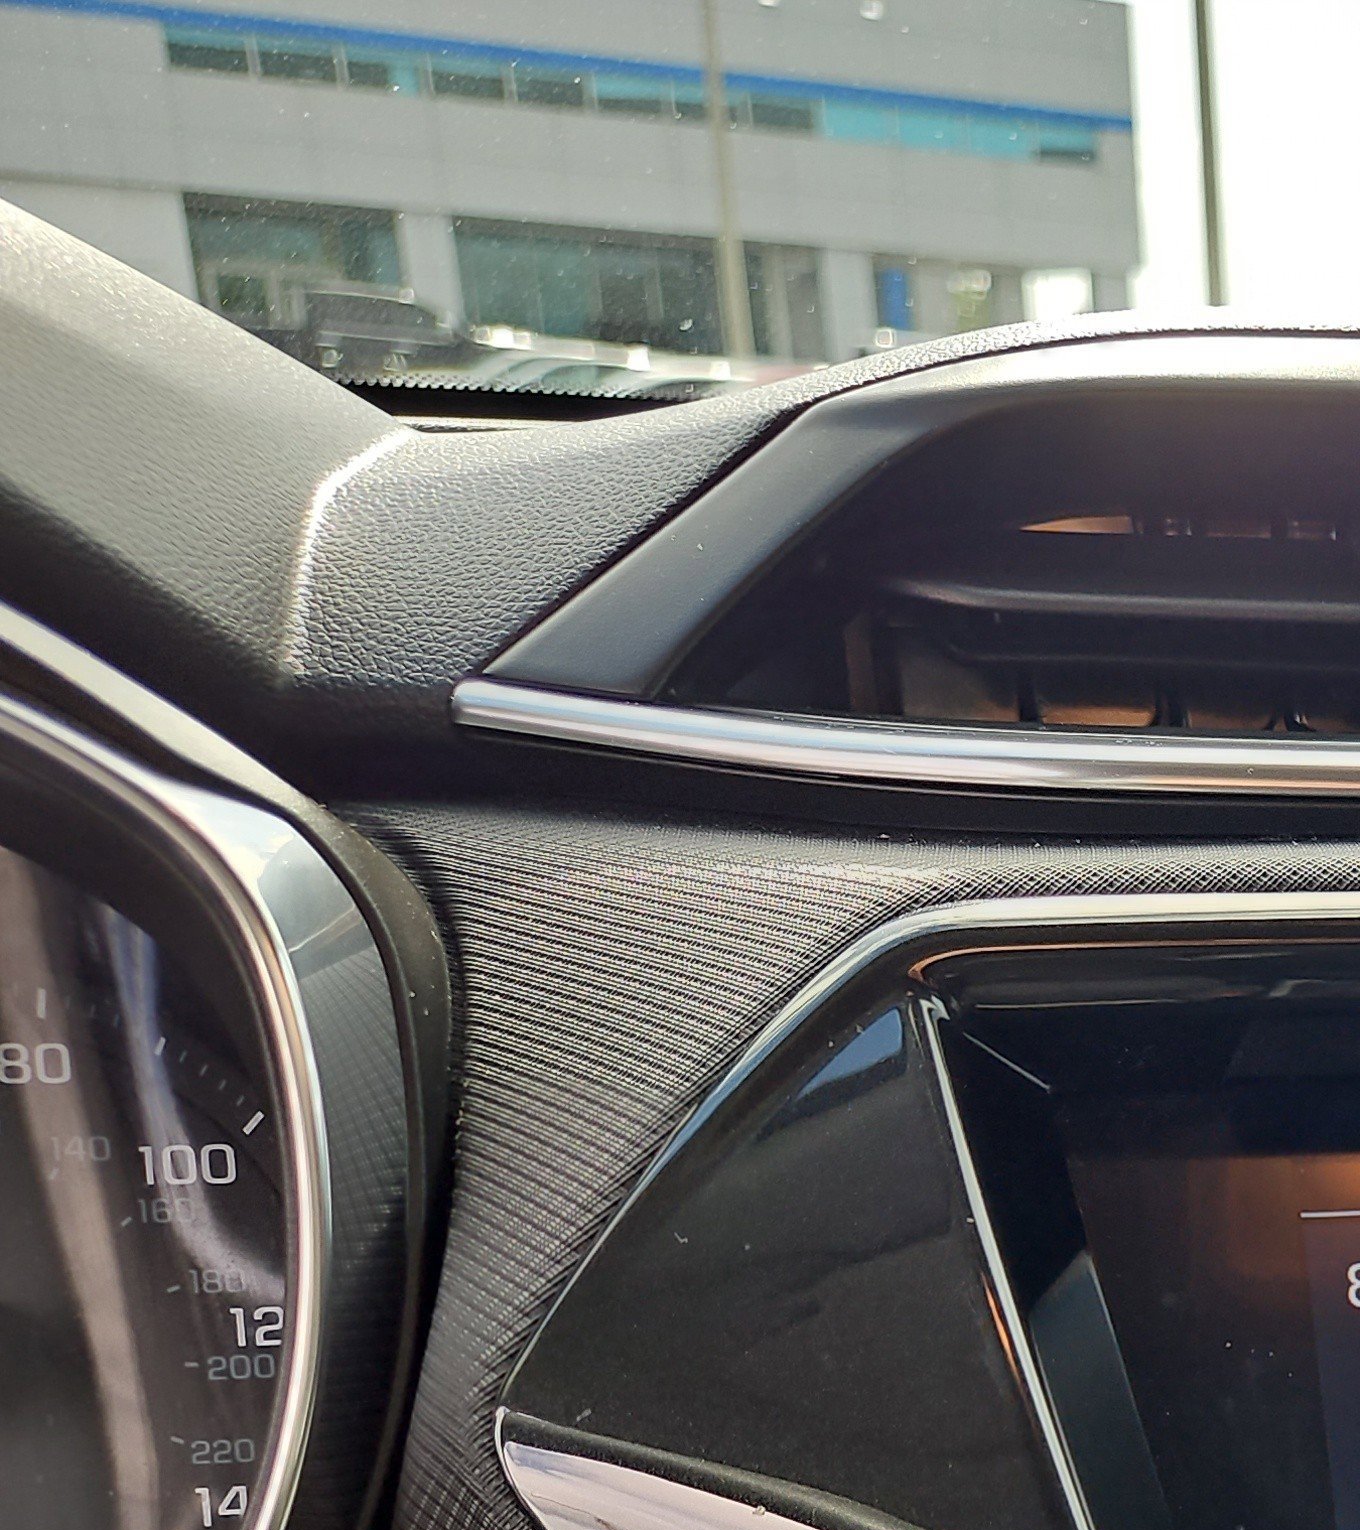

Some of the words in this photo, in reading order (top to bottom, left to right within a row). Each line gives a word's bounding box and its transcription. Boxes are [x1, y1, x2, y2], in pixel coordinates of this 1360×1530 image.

[0, 1042, 71, 1084] 80
[50, 1136, 112, 1163] 140
[138, 1144, 237, 1186] 100
[137, 1197, 198, 1224] 160
[188, 1270, 246, 1294] 180
[229, 1305, 285, 1347] 12
[206, 1353, 276, 1381] 200
[190, 1438, 256, 1465] 220
[194, 1485, 249, 1528] 14
